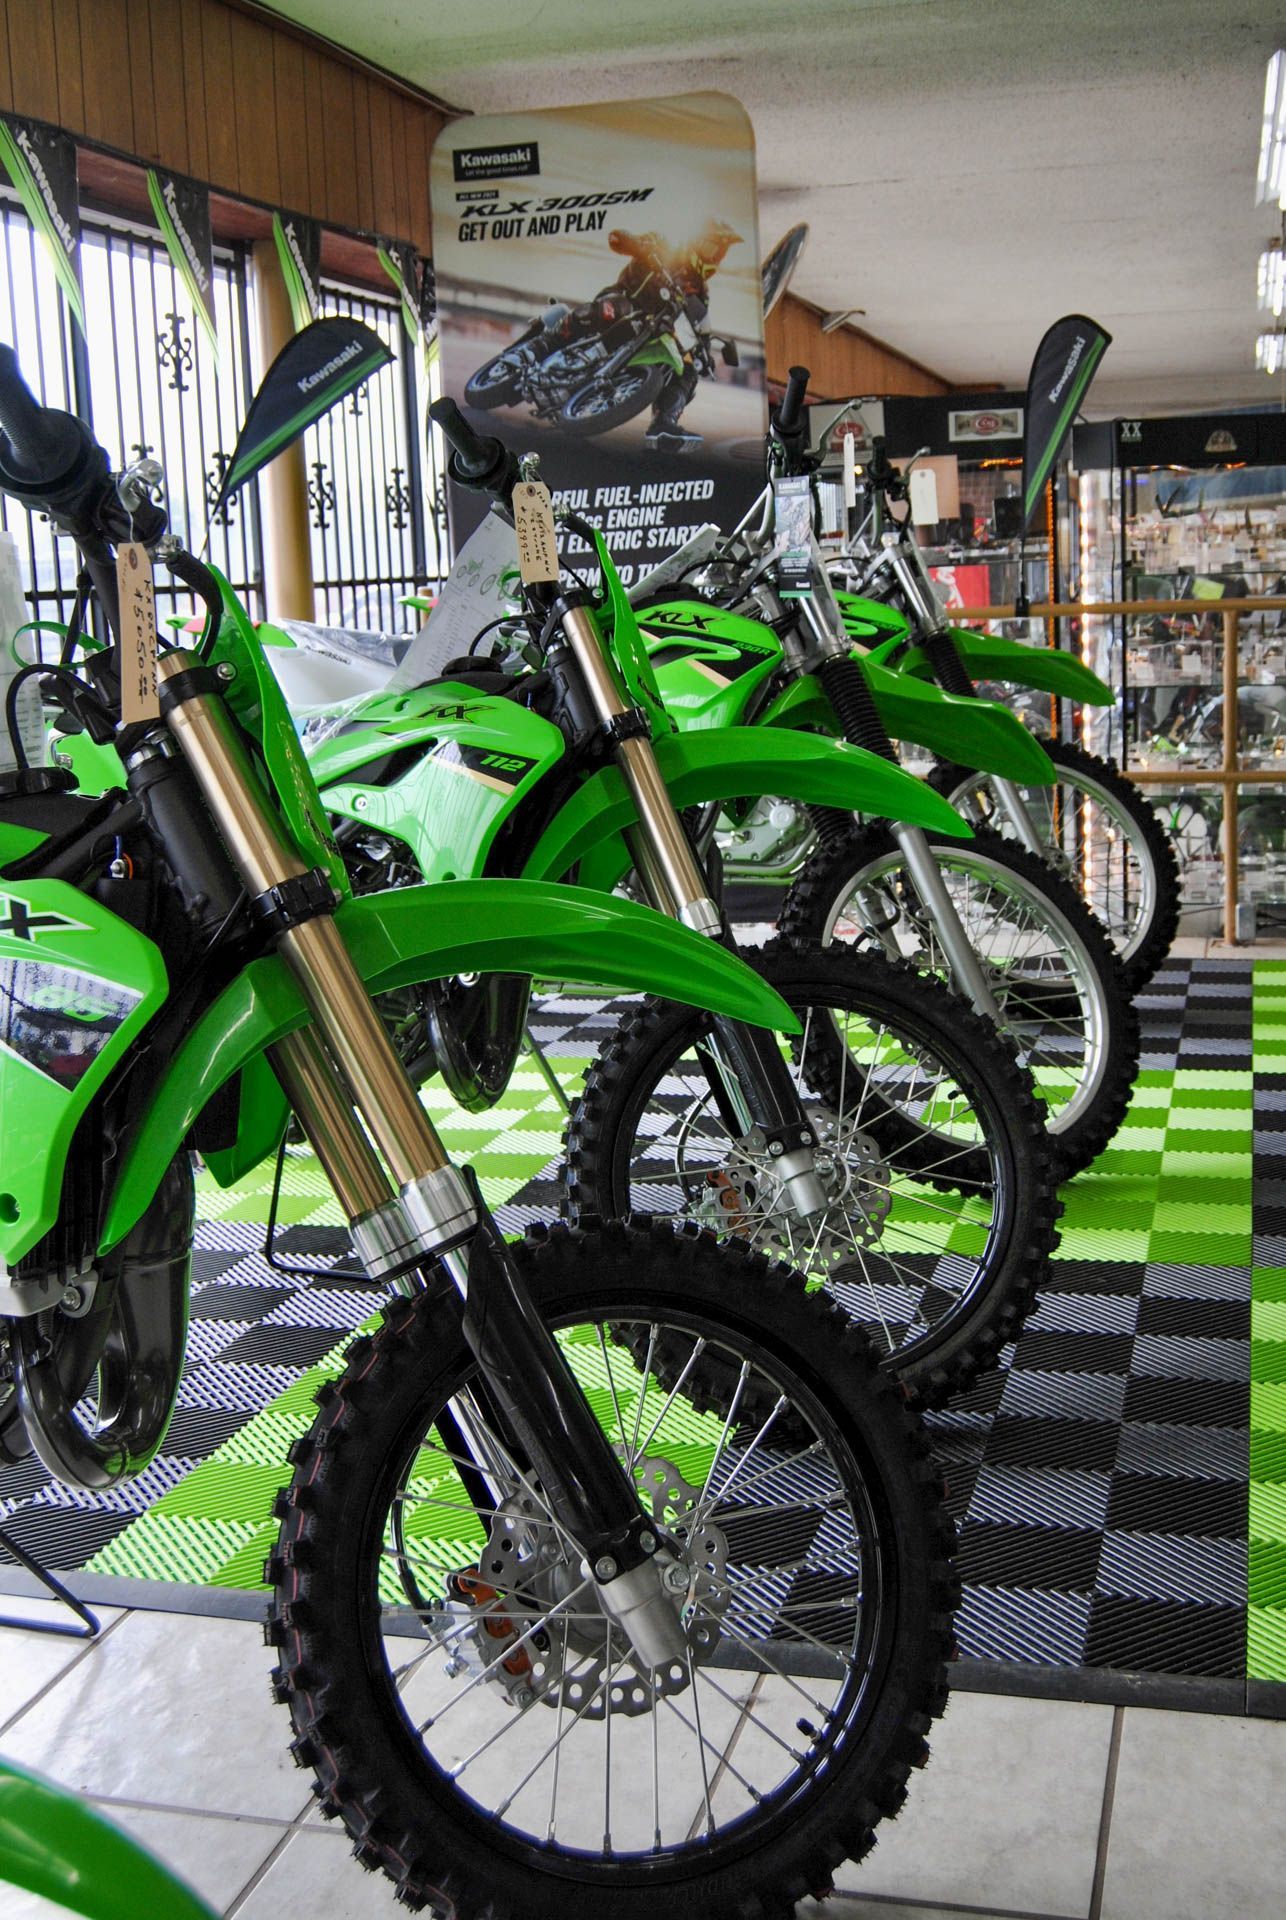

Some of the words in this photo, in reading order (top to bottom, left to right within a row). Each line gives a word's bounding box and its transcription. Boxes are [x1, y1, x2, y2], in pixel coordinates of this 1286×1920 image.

[461, 148, 532, 168] Kawasaki
[16, 130, 76, 254] Kawasaki
[460, 200, 534, 218] KLX
[163, 181, 208, 292] Kawasaki
[458, 221, 488, 242] GET
[491, 218, 525, 239] OUT
[527, 215, 561, 237] AND
[565, 210, 607, 233] PLAY
[297, 340, 363, 393] Kawasaki
[1048, 336, 1086, 404] Kawasaki
[594, 479, 715, 508] FUEL-INJECTED
[607, 505, 667, 529] ENGINE
[643, 610, 722, 632] KLX
[480, 754, 527, 772] 112
